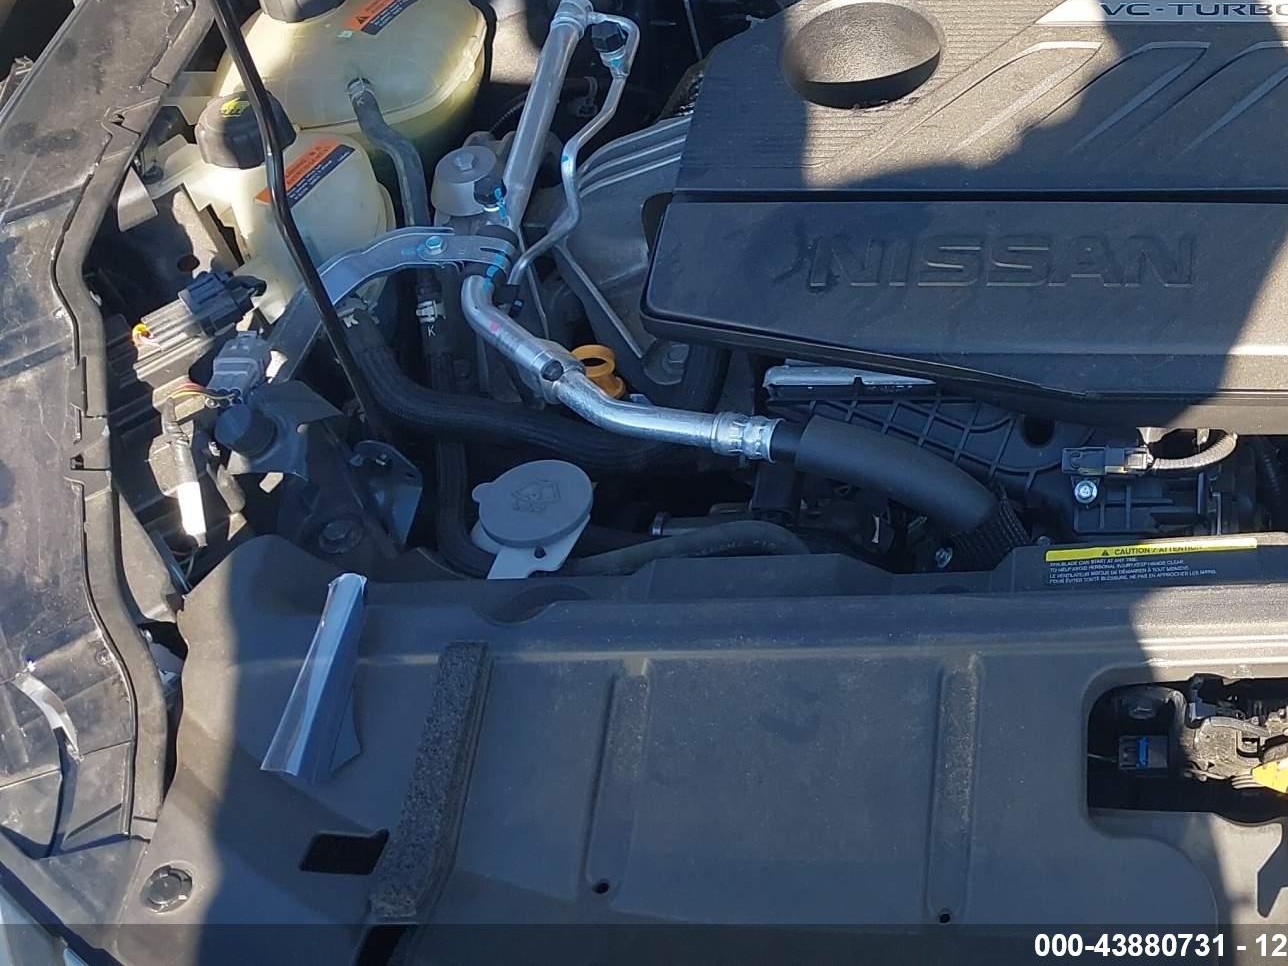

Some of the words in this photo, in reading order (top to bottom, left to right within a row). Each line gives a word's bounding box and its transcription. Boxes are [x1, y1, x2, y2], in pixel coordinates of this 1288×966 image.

[808, 234, 1194, 287] NISSAN
[427, 325, 436, 337] K
[1114, 547, 1150, 555] CAUTION
